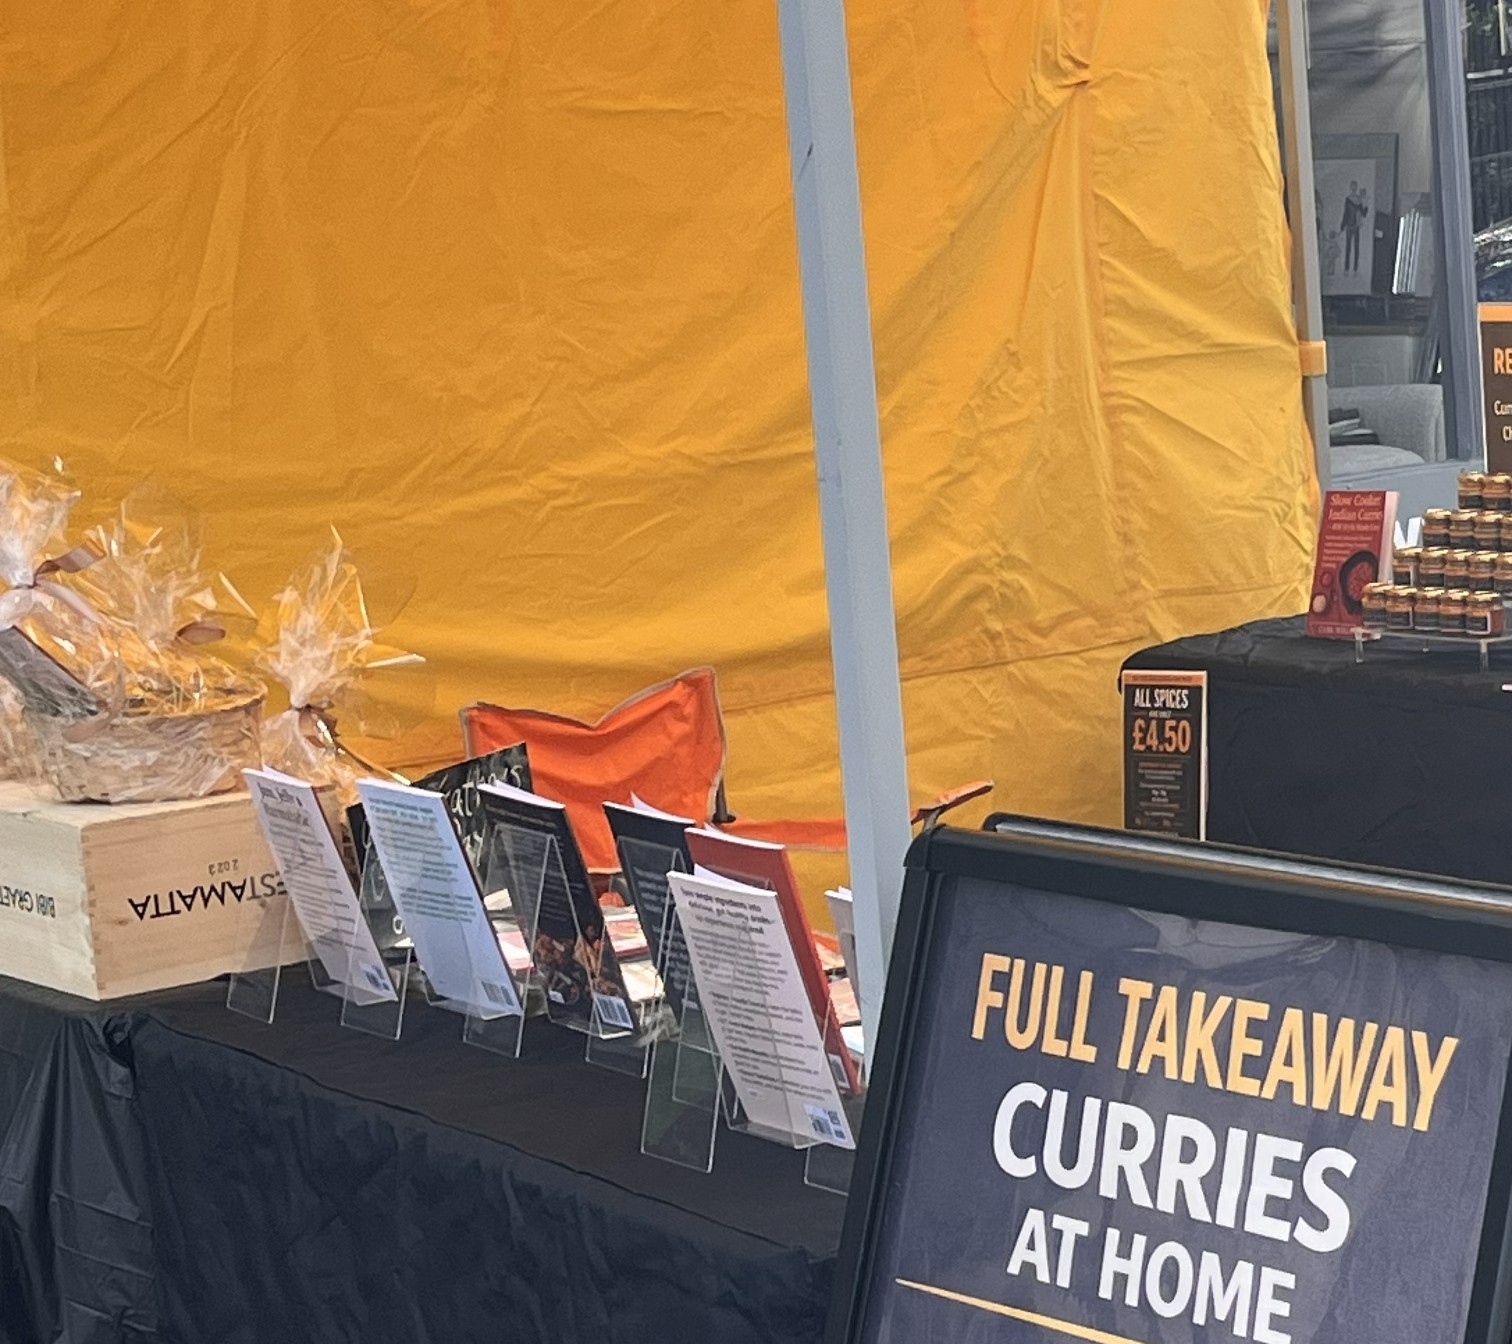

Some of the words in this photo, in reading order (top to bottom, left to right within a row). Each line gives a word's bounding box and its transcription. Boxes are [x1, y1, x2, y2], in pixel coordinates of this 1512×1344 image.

[1132, 718, 1191, 753] £4.50
[1134, 688, 1151, 707] ALL
[1154, 688, 1189, 709] SPICES
[971, 953, 1098, 1063] FULL
[1116, 977, 1460, 1132] TAKEAWAY
[992, 1082, 1358, 1253] CURRIES
[1006, 1208, 1089, 1285] AT
